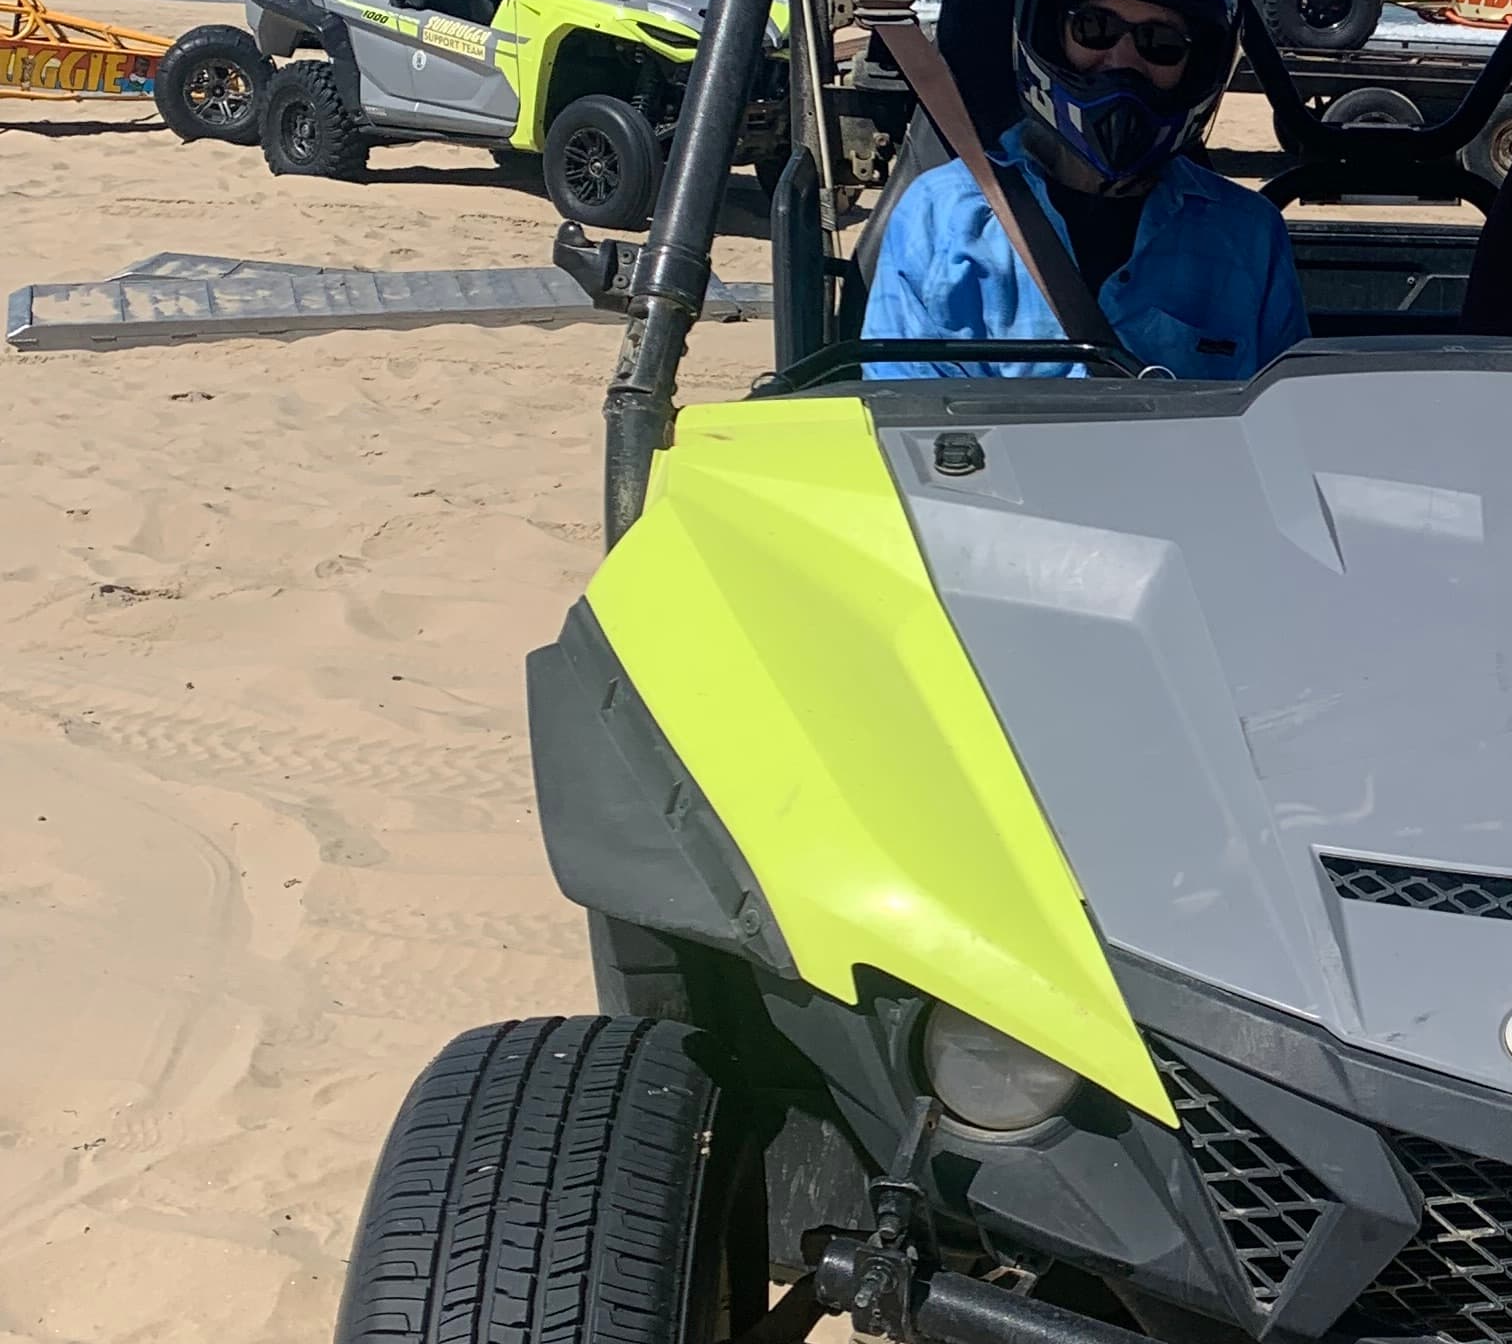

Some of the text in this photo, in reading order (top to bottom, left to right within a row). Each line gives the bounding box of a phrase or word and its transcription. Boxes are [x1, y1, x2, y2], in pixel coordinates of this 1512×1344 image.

[363, 10, 389, 24] 1000
[424, 16, 492, 44] SUNBUGGY
[424, 32, 484, 58] SUPPORT TEAM
[0, 47, 127, 93] UGGIE
